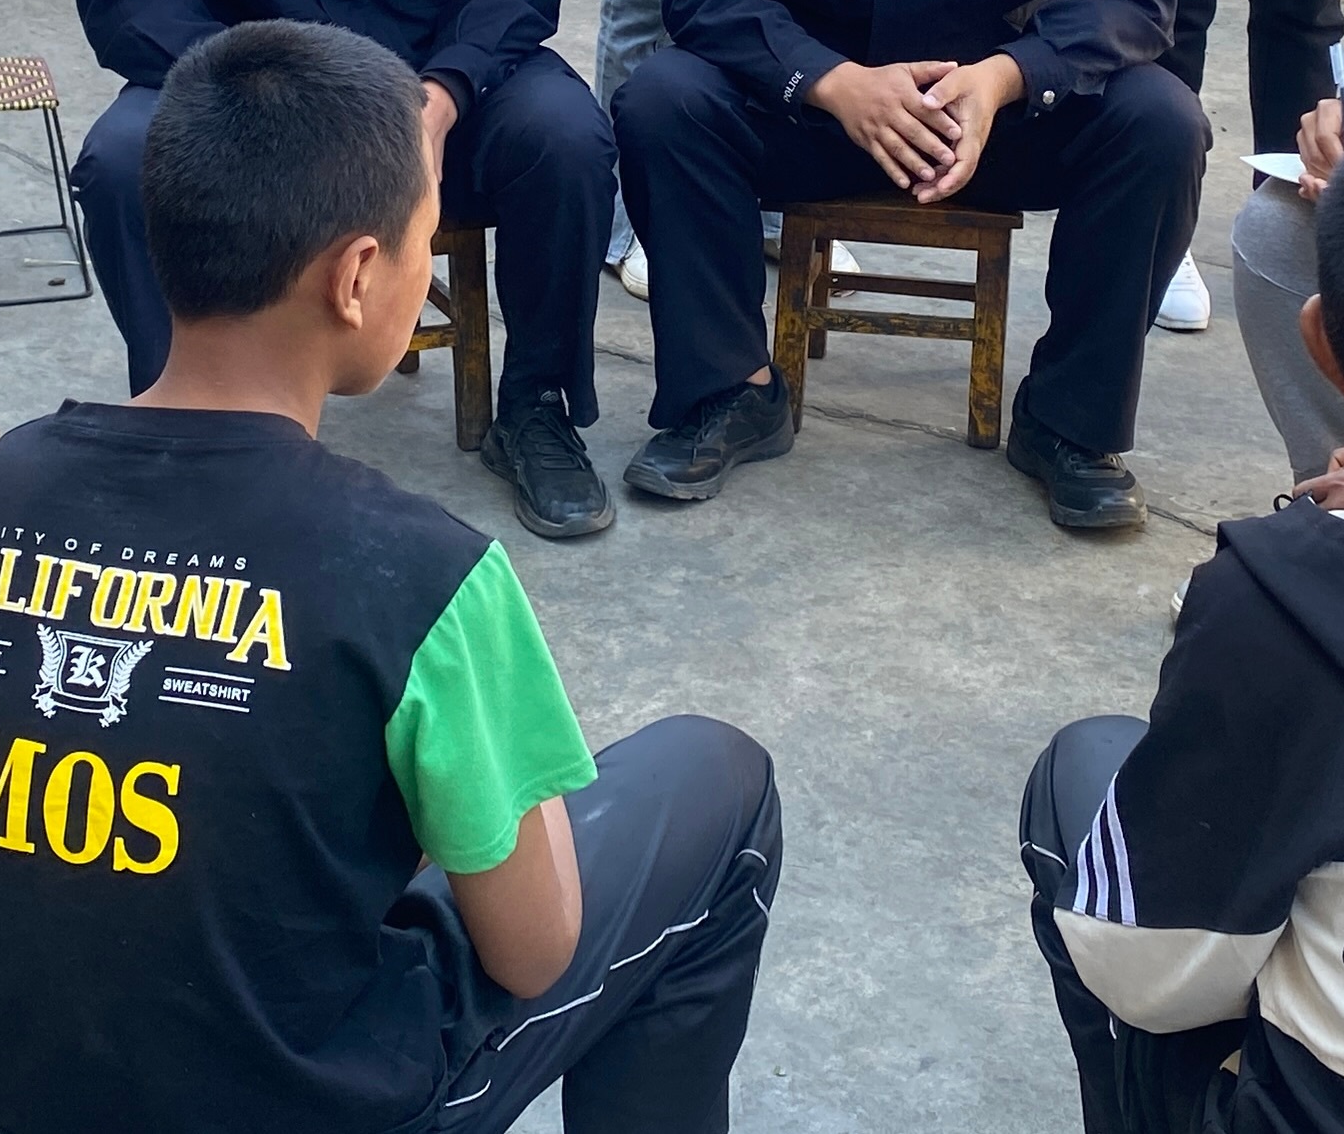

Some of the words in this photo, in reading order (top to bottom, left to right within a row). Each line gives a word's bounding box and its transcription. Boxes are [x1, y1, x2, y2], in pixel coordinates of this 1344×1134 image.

[783, 70, 804, 104] POLICE
[65, 538, 102, 554] OF
[122, 547, 248, 572] DREAMS
[162, 678, 252, 702] SWEATSHIRT
